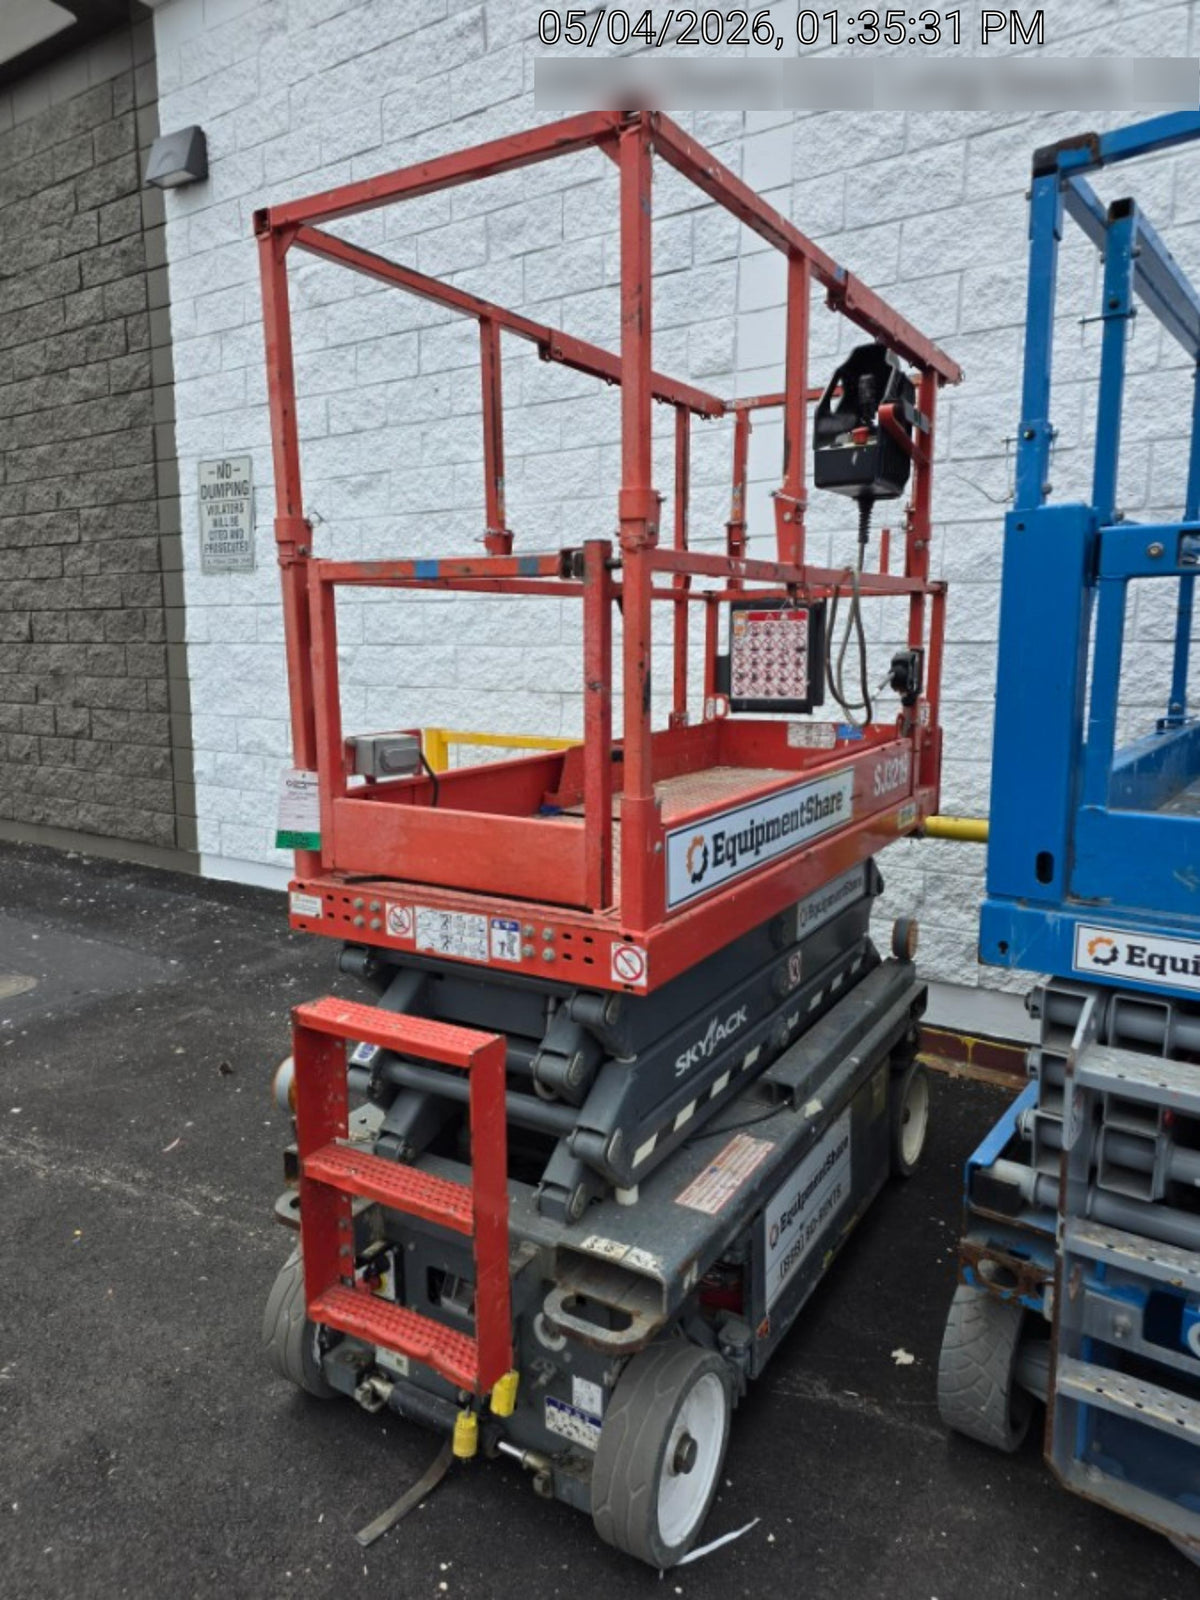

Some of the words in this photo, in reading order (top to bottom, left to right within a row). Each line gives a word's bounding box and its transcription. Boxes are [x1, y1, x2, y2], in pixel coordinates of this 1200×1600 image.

[201, 480, 249, 500] DUMPING
[206, 502, 244, 515] VIOLATORS
[711, 790, 844, 868] EquipmentShare
[675, 1004, 747, 1077] SKYJACK
[779, 1135, 849, 1234] EquipmentShare
